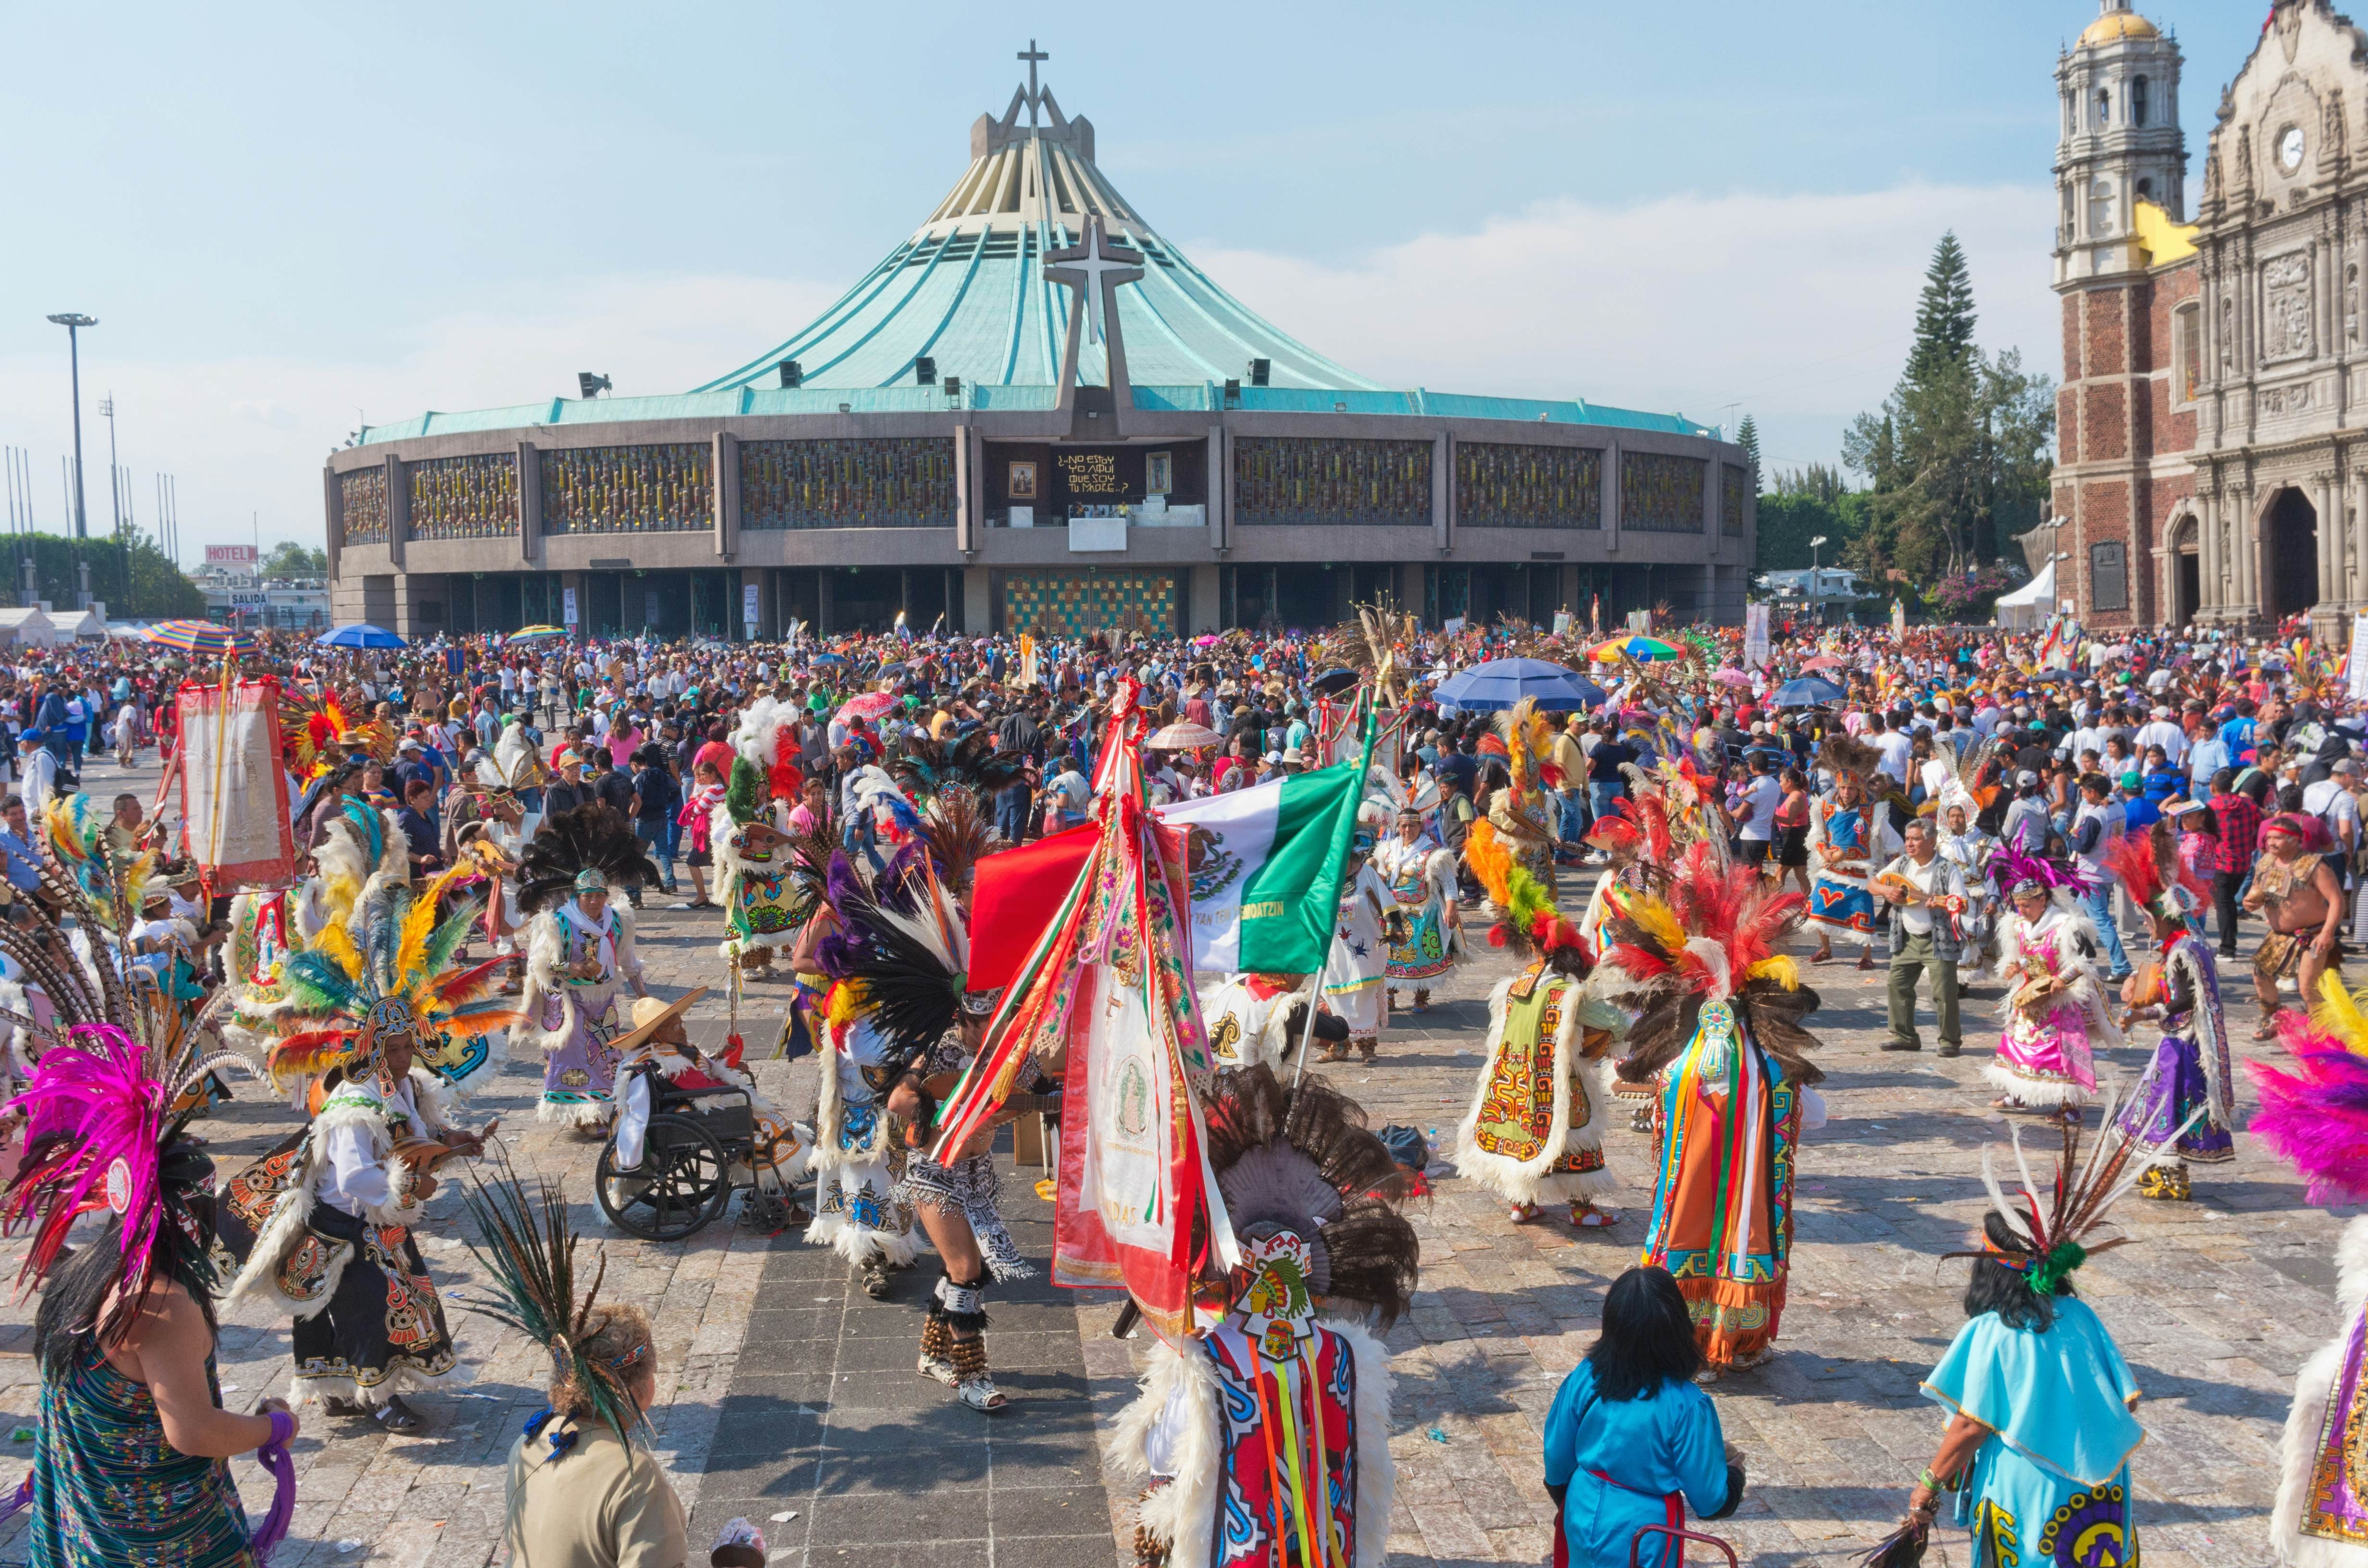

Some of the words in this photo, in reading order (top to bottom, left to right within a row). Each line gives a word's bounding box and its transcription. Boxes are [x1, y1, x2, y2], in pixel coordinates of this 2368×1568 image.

[1069, 465, 1085, 473] YO
[1069, 475, 1090, 483] QUE
[1092, 474, 1115, 482] SOY
[1068, 483, 1079, 492] TU
[208, 547, 246, 560] HOTEL
[232, 594, 267, 604] SALIDA
[244, 761, 258, 784] CRUCES
